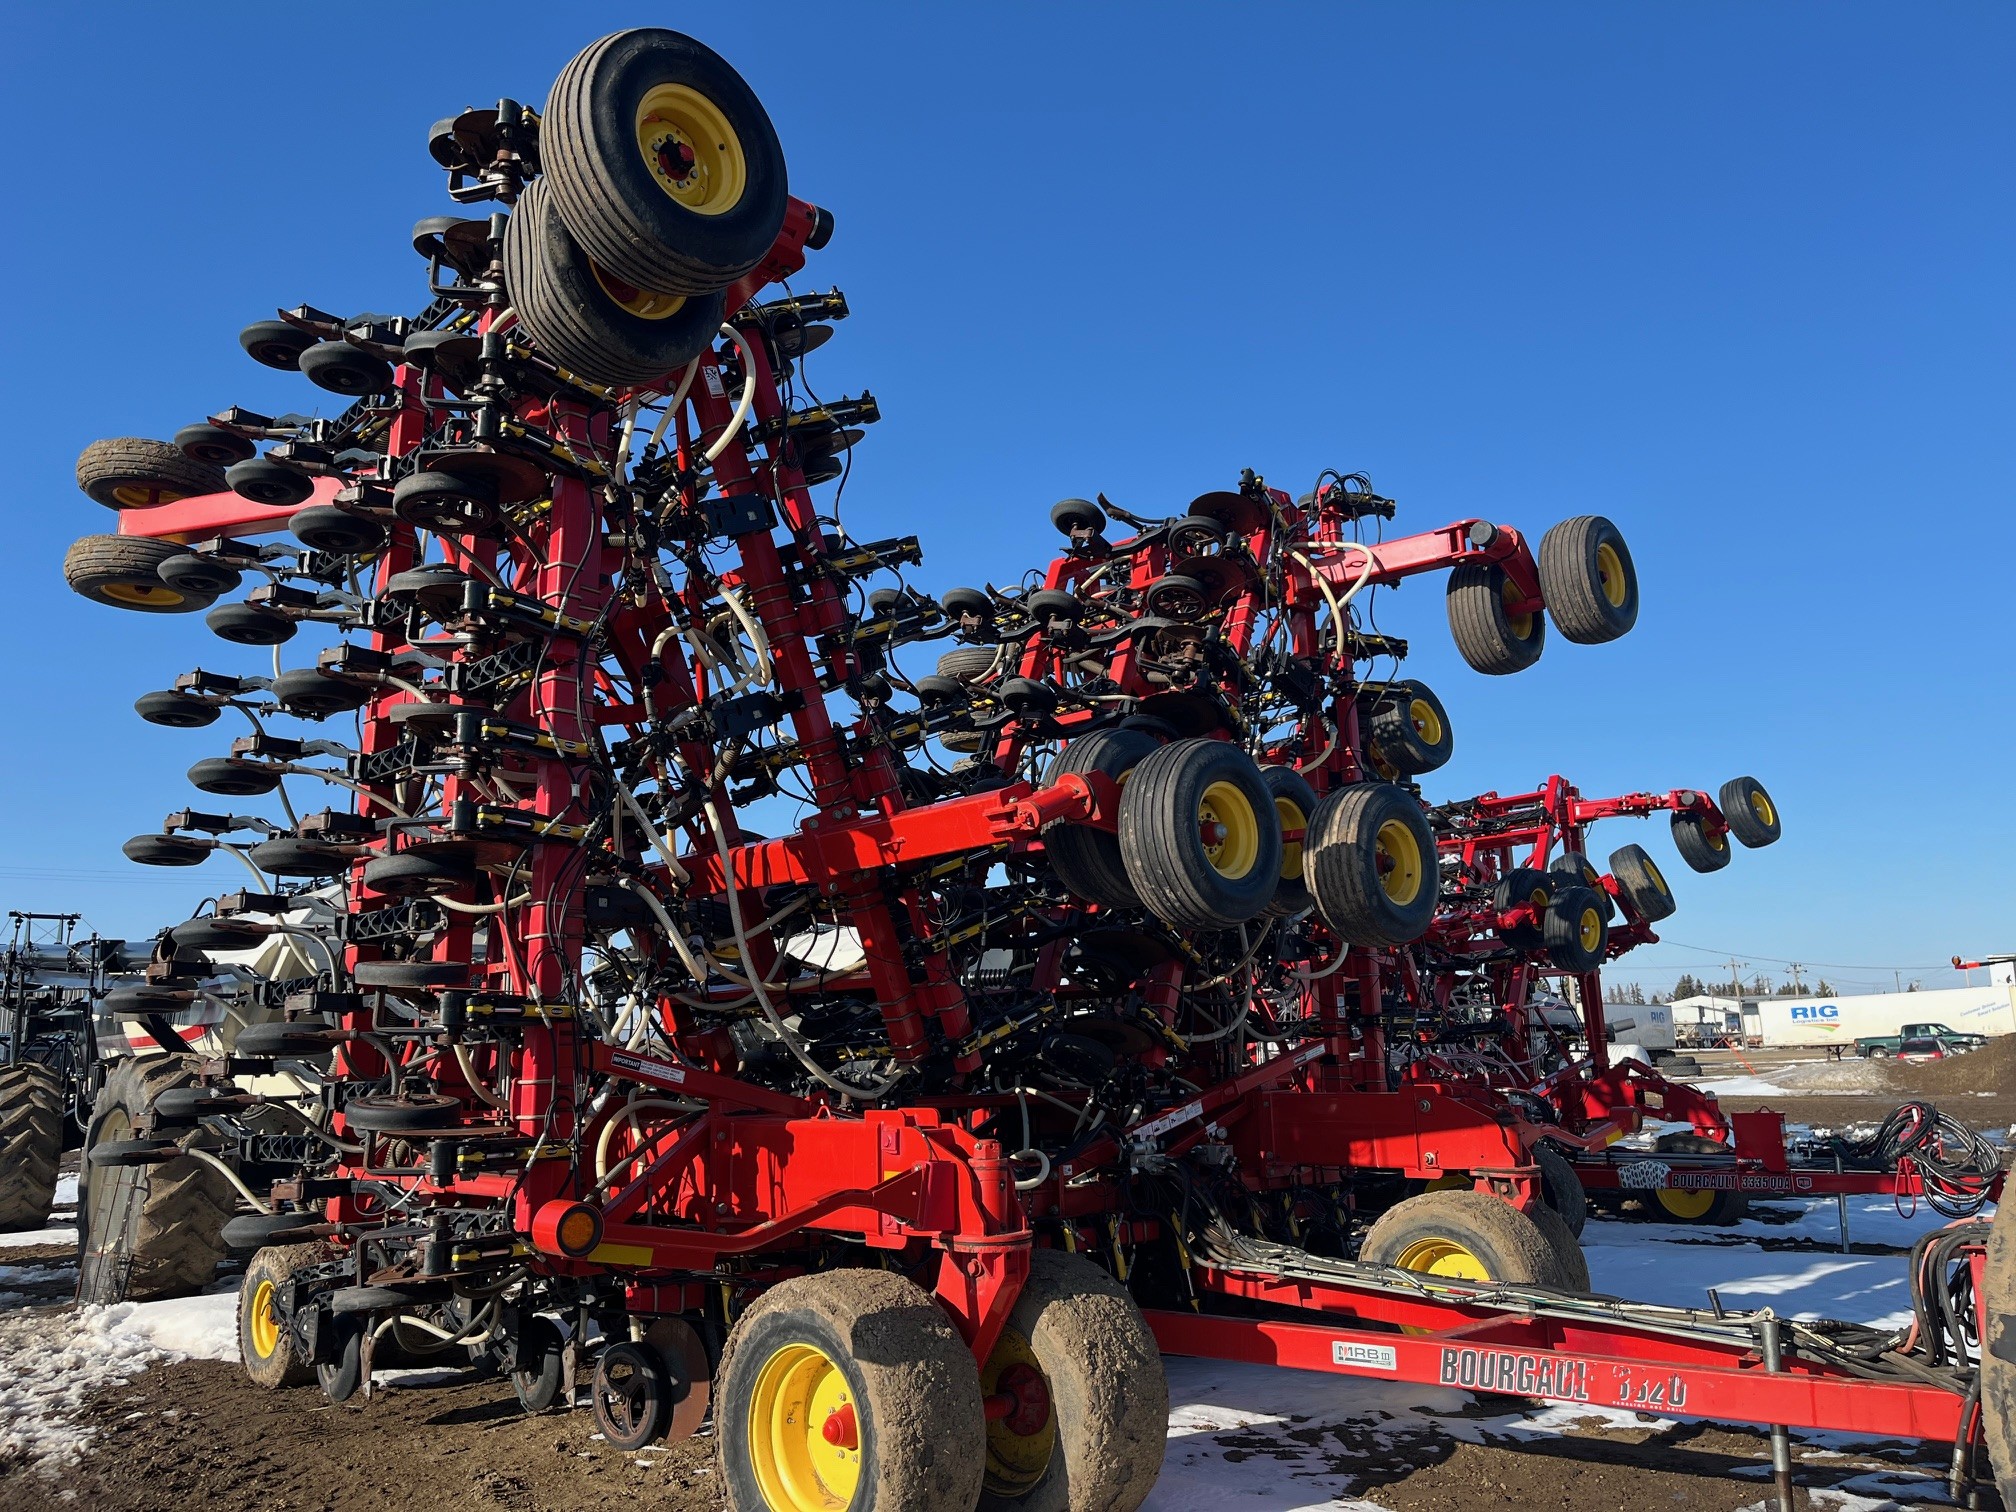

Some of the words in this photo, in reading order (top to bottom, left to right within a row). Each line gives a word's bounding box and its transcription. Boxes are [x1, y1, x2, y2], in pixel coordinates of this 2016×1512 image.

[1650, 1011, 1666, 1024] RIG
[1791, 1005, 1838, 1019] RIG
[613, 1056, 640, 1068] IMPORTANT
[1672, 1173, 1736, 1190] BOURGAULT
[1338, 1345, 1379, 1360] MRB
[1440, 1348, 1597, 1400] BOURGAUL
